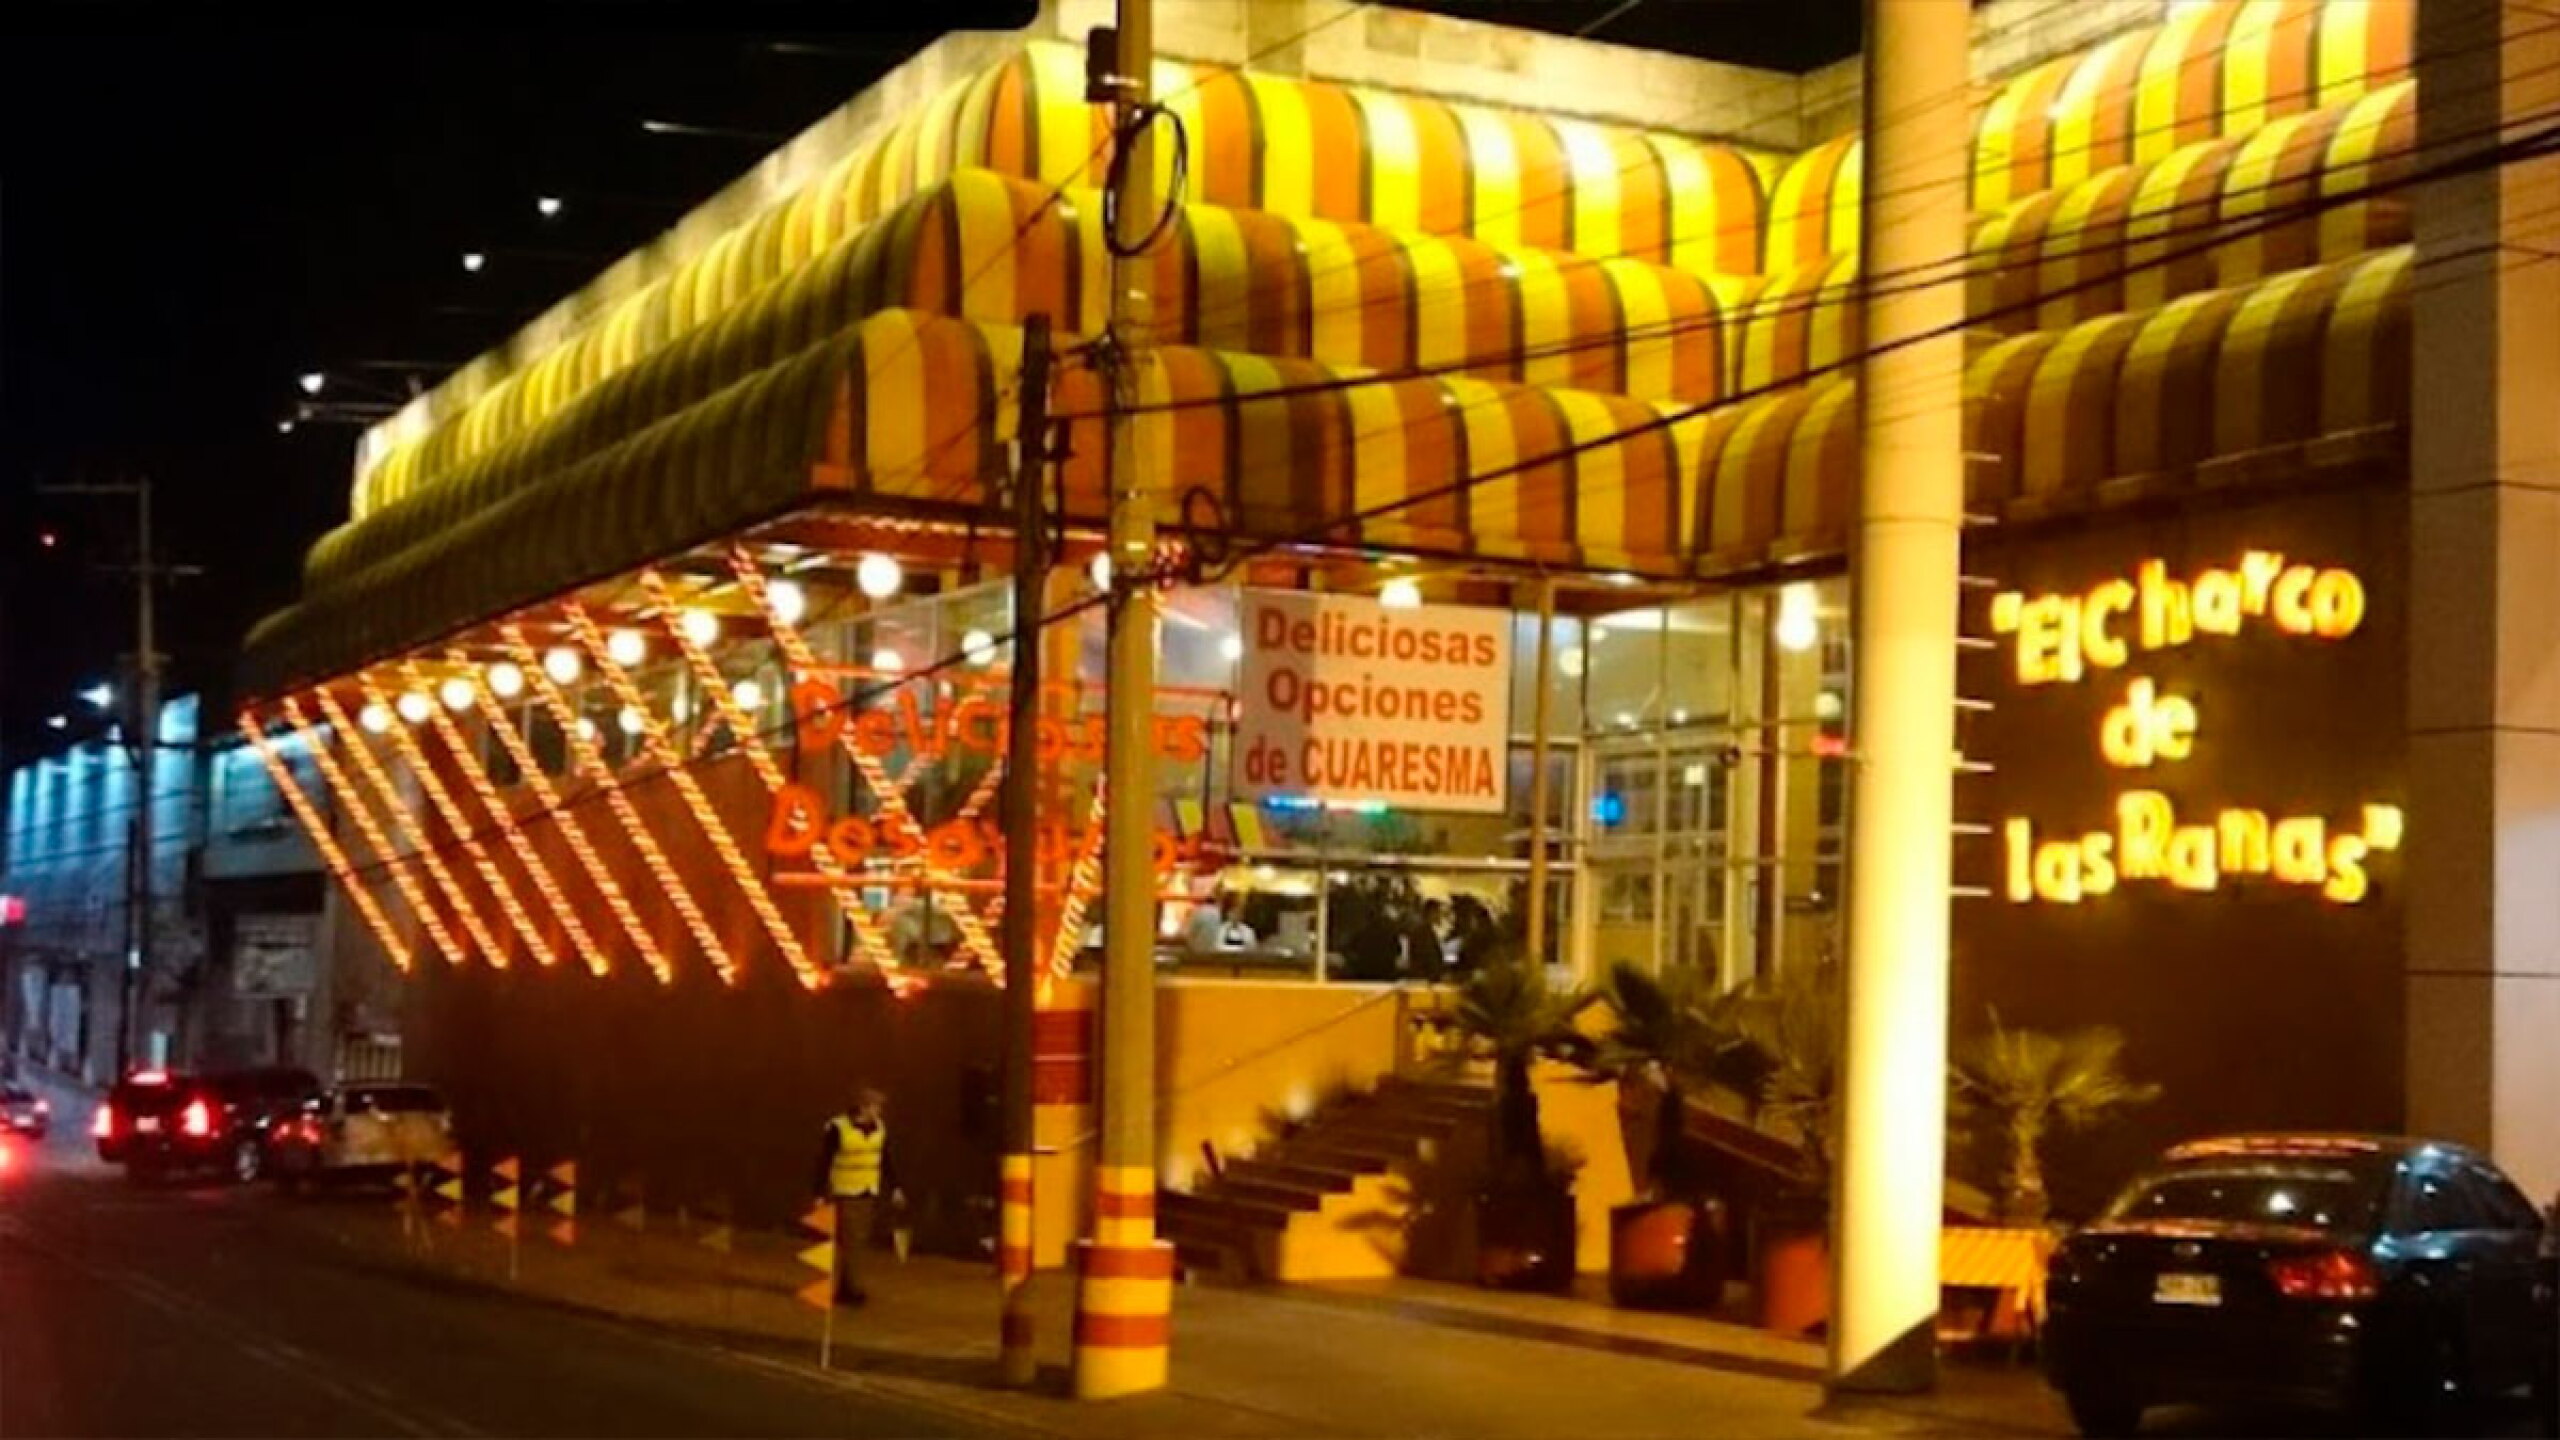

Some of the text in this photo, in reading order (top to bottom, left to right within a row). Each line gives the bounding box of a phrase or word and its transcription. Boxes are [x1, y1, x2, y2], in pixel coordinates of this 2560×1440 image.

[1257, 606, 1497, 667] Deliciosas
[2082, 550, 2366, 668] Charco
[1266, 667, 1485, 725] Opciones
[2101, 676, 2197, 767] de
[1245, 734, 1496, 797] de CUARESMA
[2006, 816, 2117, 903] las
